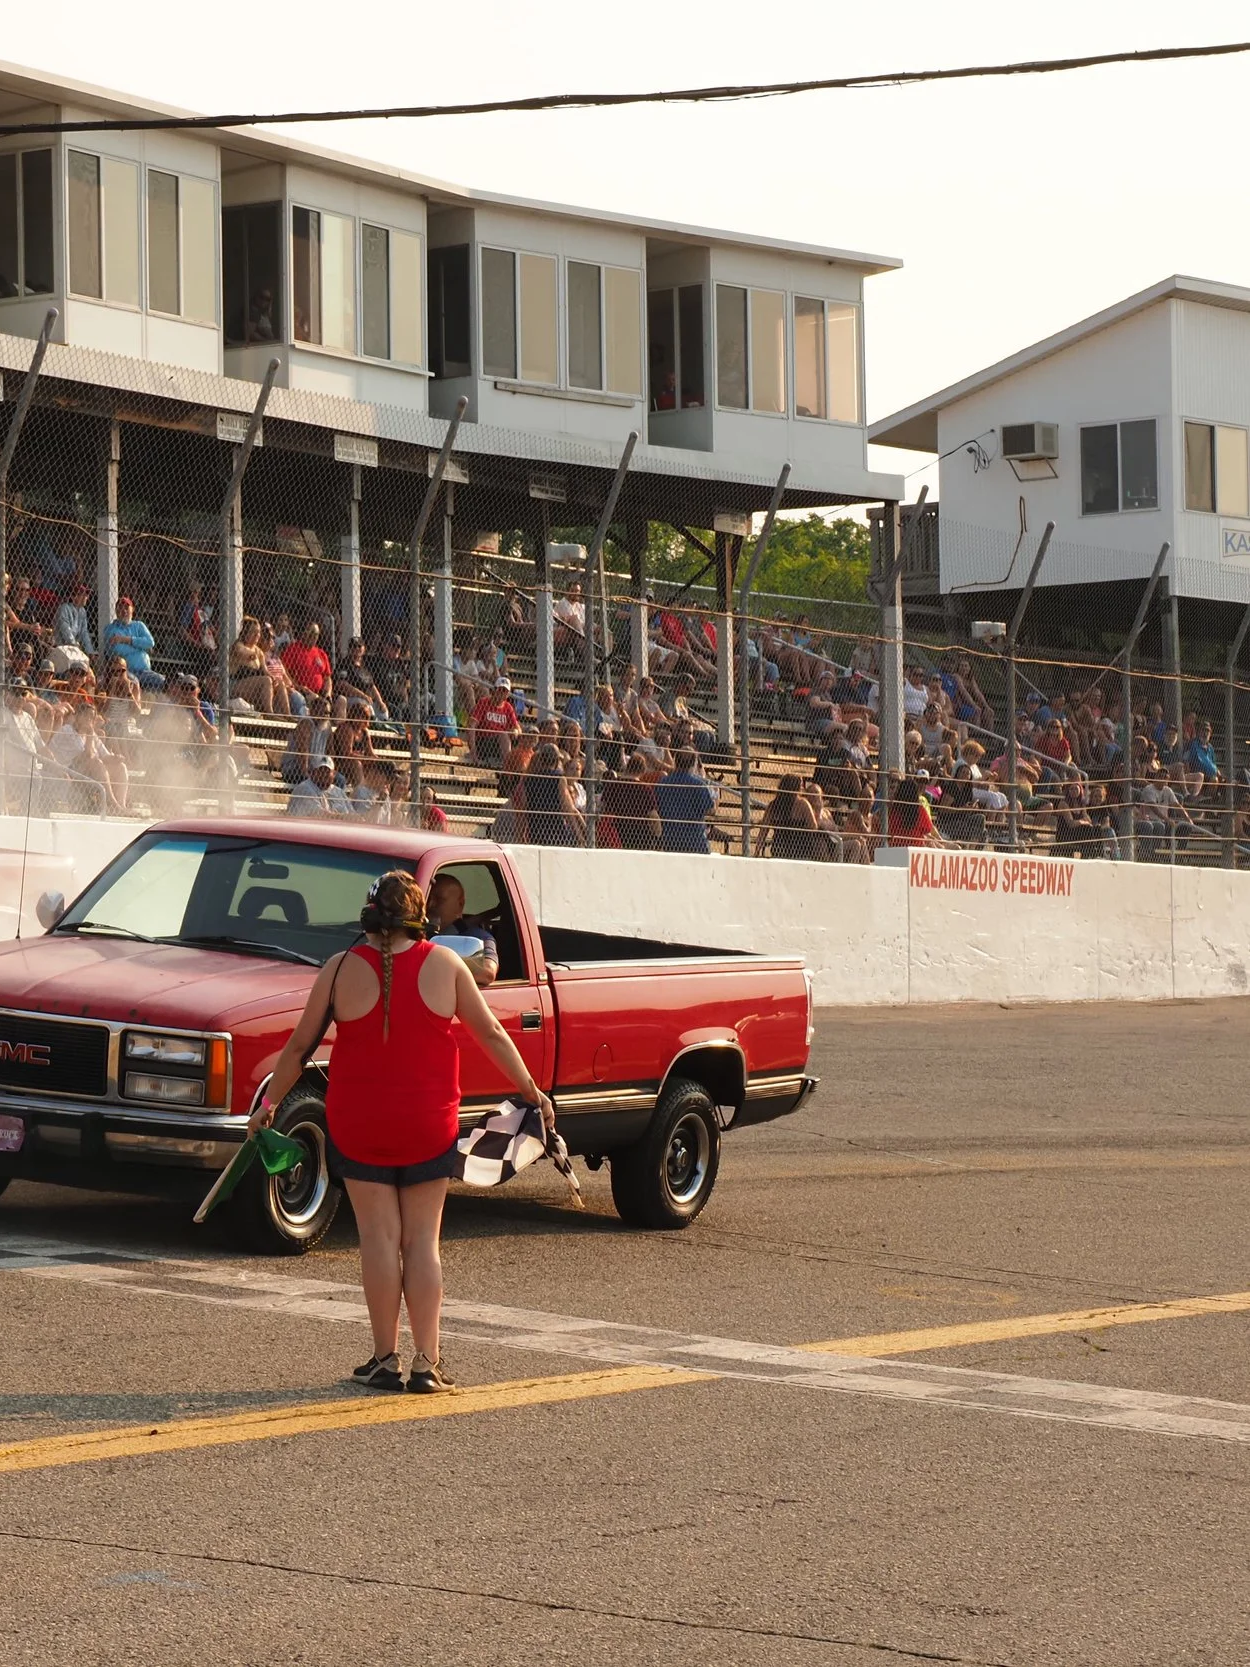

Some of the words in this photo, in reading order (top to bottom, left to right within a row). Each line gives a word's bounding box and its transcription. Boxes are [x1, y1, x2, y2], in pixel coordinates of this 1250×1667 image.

[1225, 532, 1250, 554] KA
[910, 853, 998, 892] KALAMAZOO
[1002, 859, 1074, 896] SPEEDWAY
